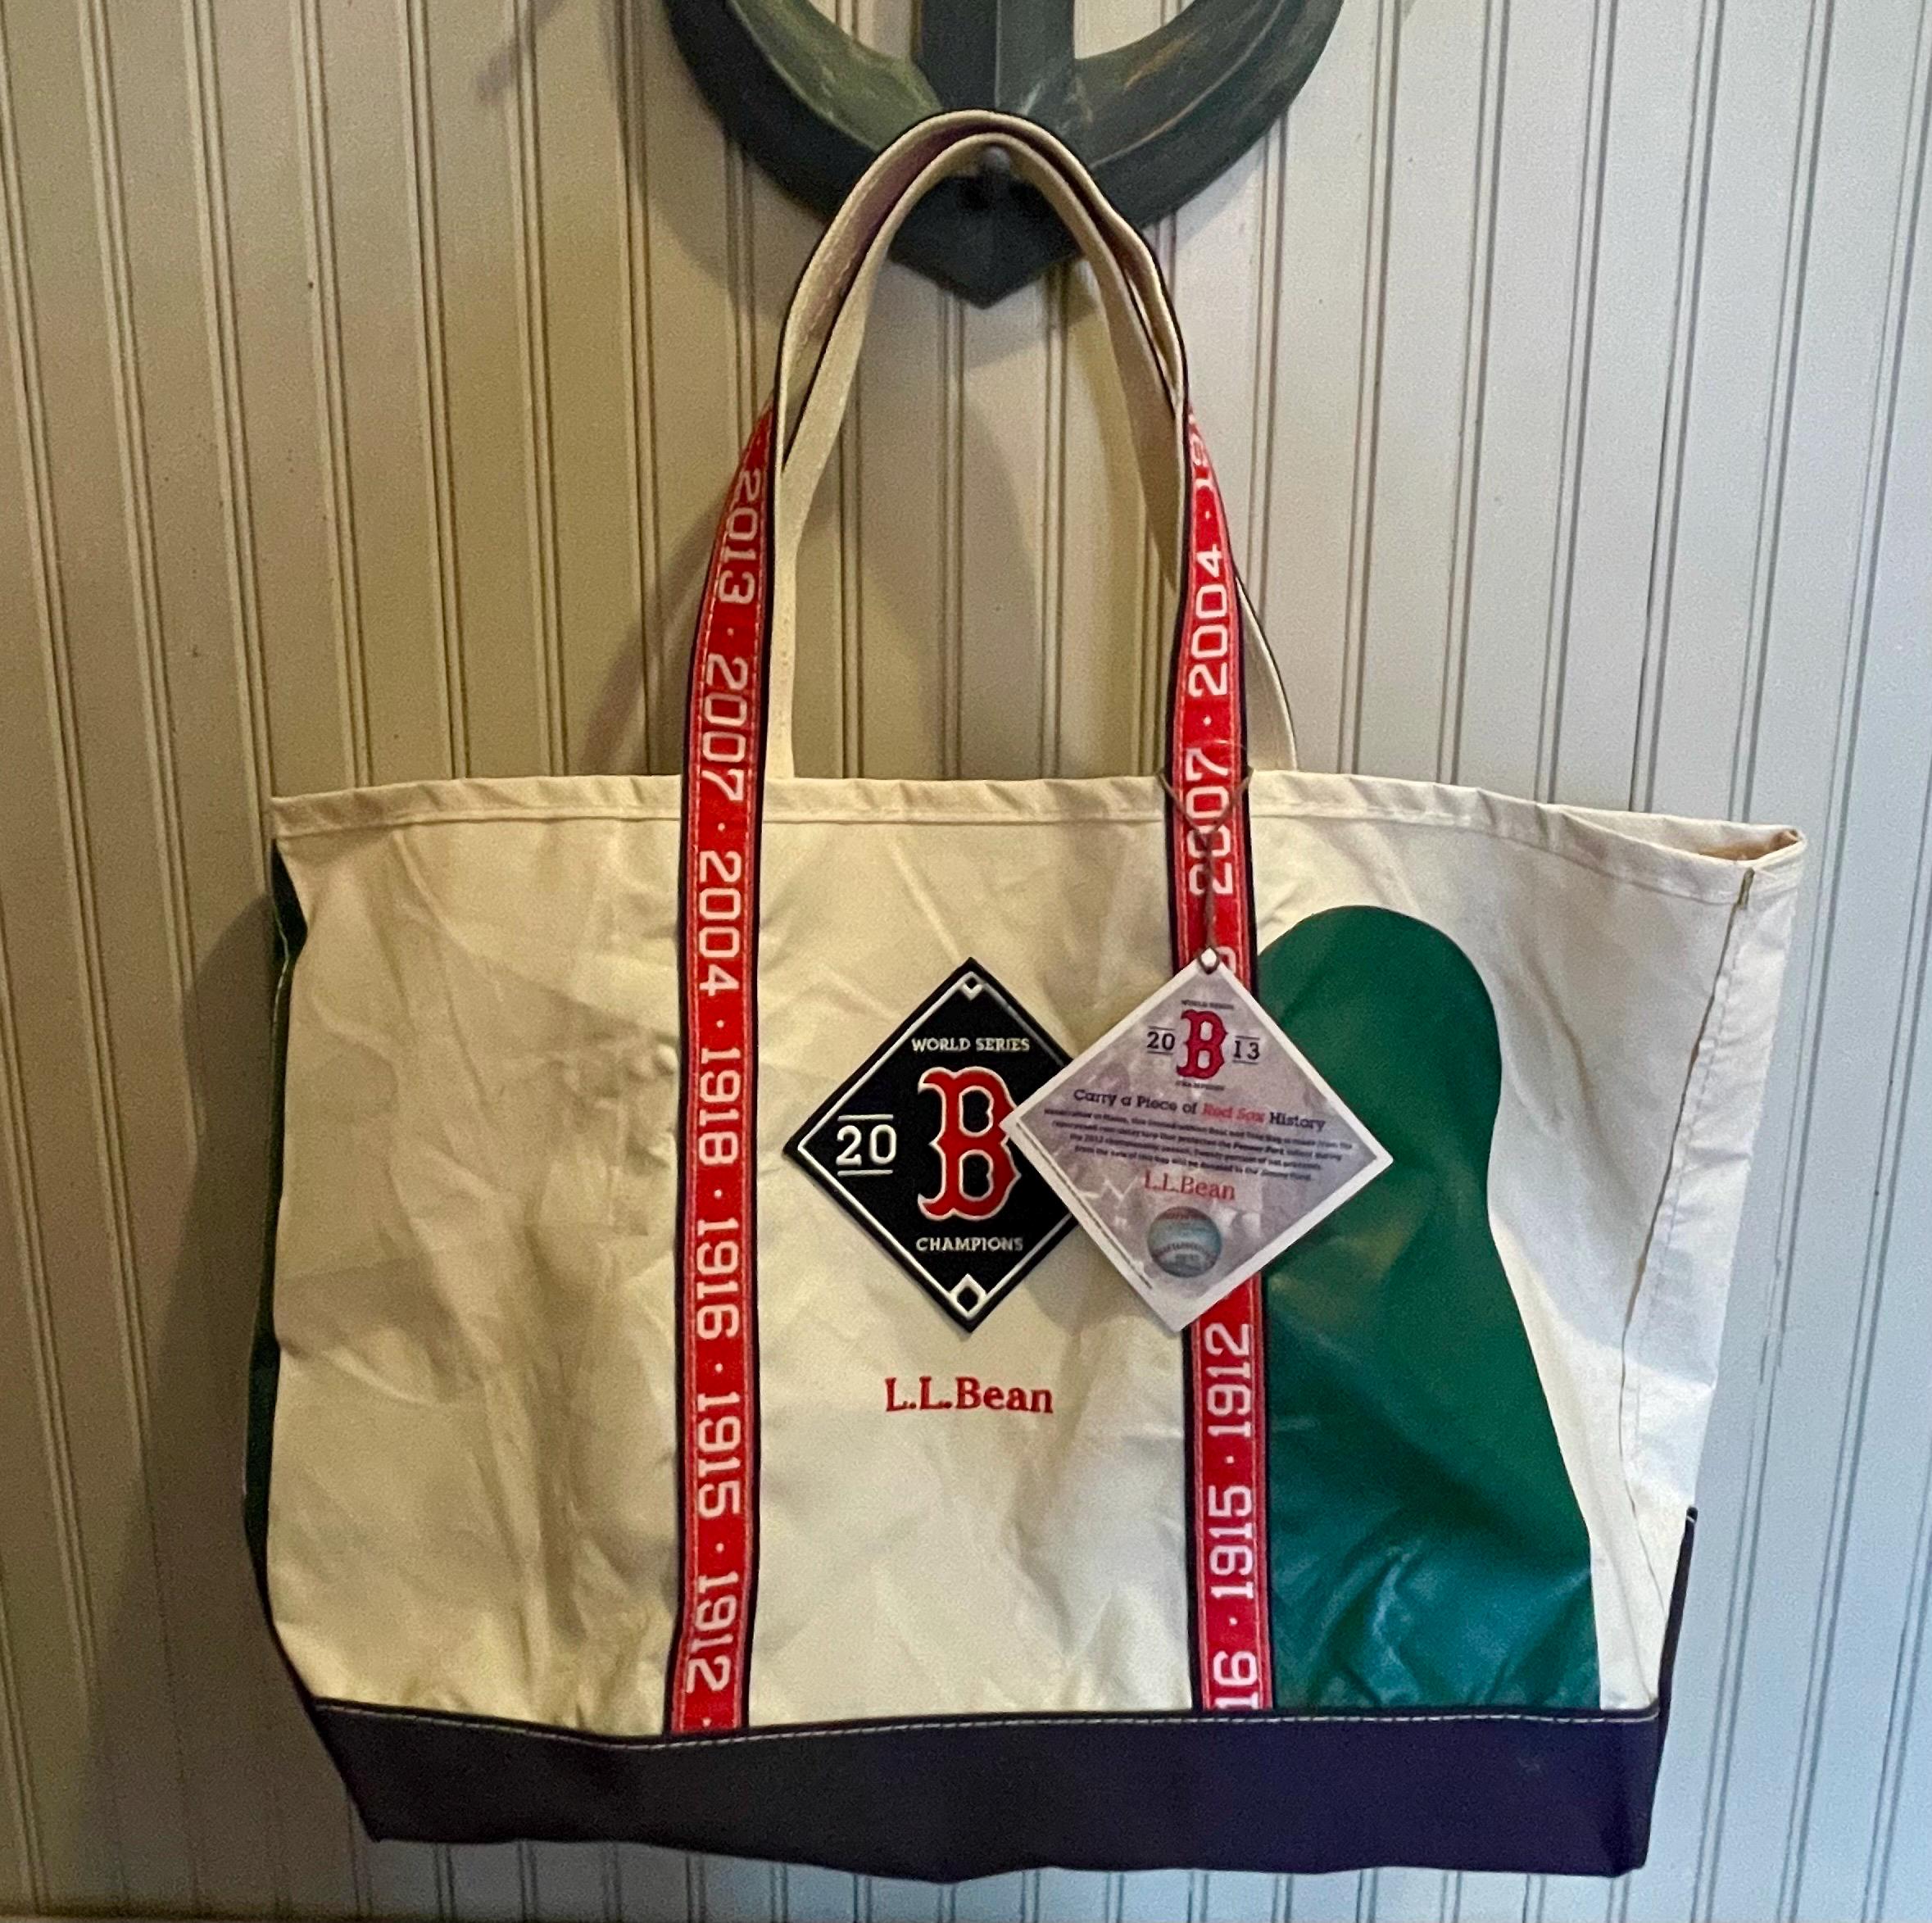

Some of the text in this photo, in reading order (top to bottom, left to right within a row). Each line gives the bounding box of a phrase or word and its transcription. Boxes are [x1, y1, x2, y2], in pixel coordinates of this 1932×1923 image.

[1189, 544, 1227, 697] 2004
[1185, 747, 1233, 896] 2007
[686, 469, 763, 1694] 2013 2007 2004 1918 1916 1915 1912
[912, 1036, 1030, 1053] WORLD SERIES
[1147, 1009, 1260, 1080] 20 B 13
[836, 1066, 1022, 1221] 20 B
[1073, 1089, 1118, 1106] Carry
[1120, 1095, 1132, 1106] a
[1136, 1095, 1177, 1111] Piece
[1181, 1101, 1198, 1114] of
[1269, 1111, 1326, 1132] History
[916, 1236, 1023, 1252] CHAMPIONS
[885, 1376, 1054, 1414] L.L.Bean
[1204, 1322, 1251, 1439] 1912
[1208, 1485, 1254, 1600] 1915
